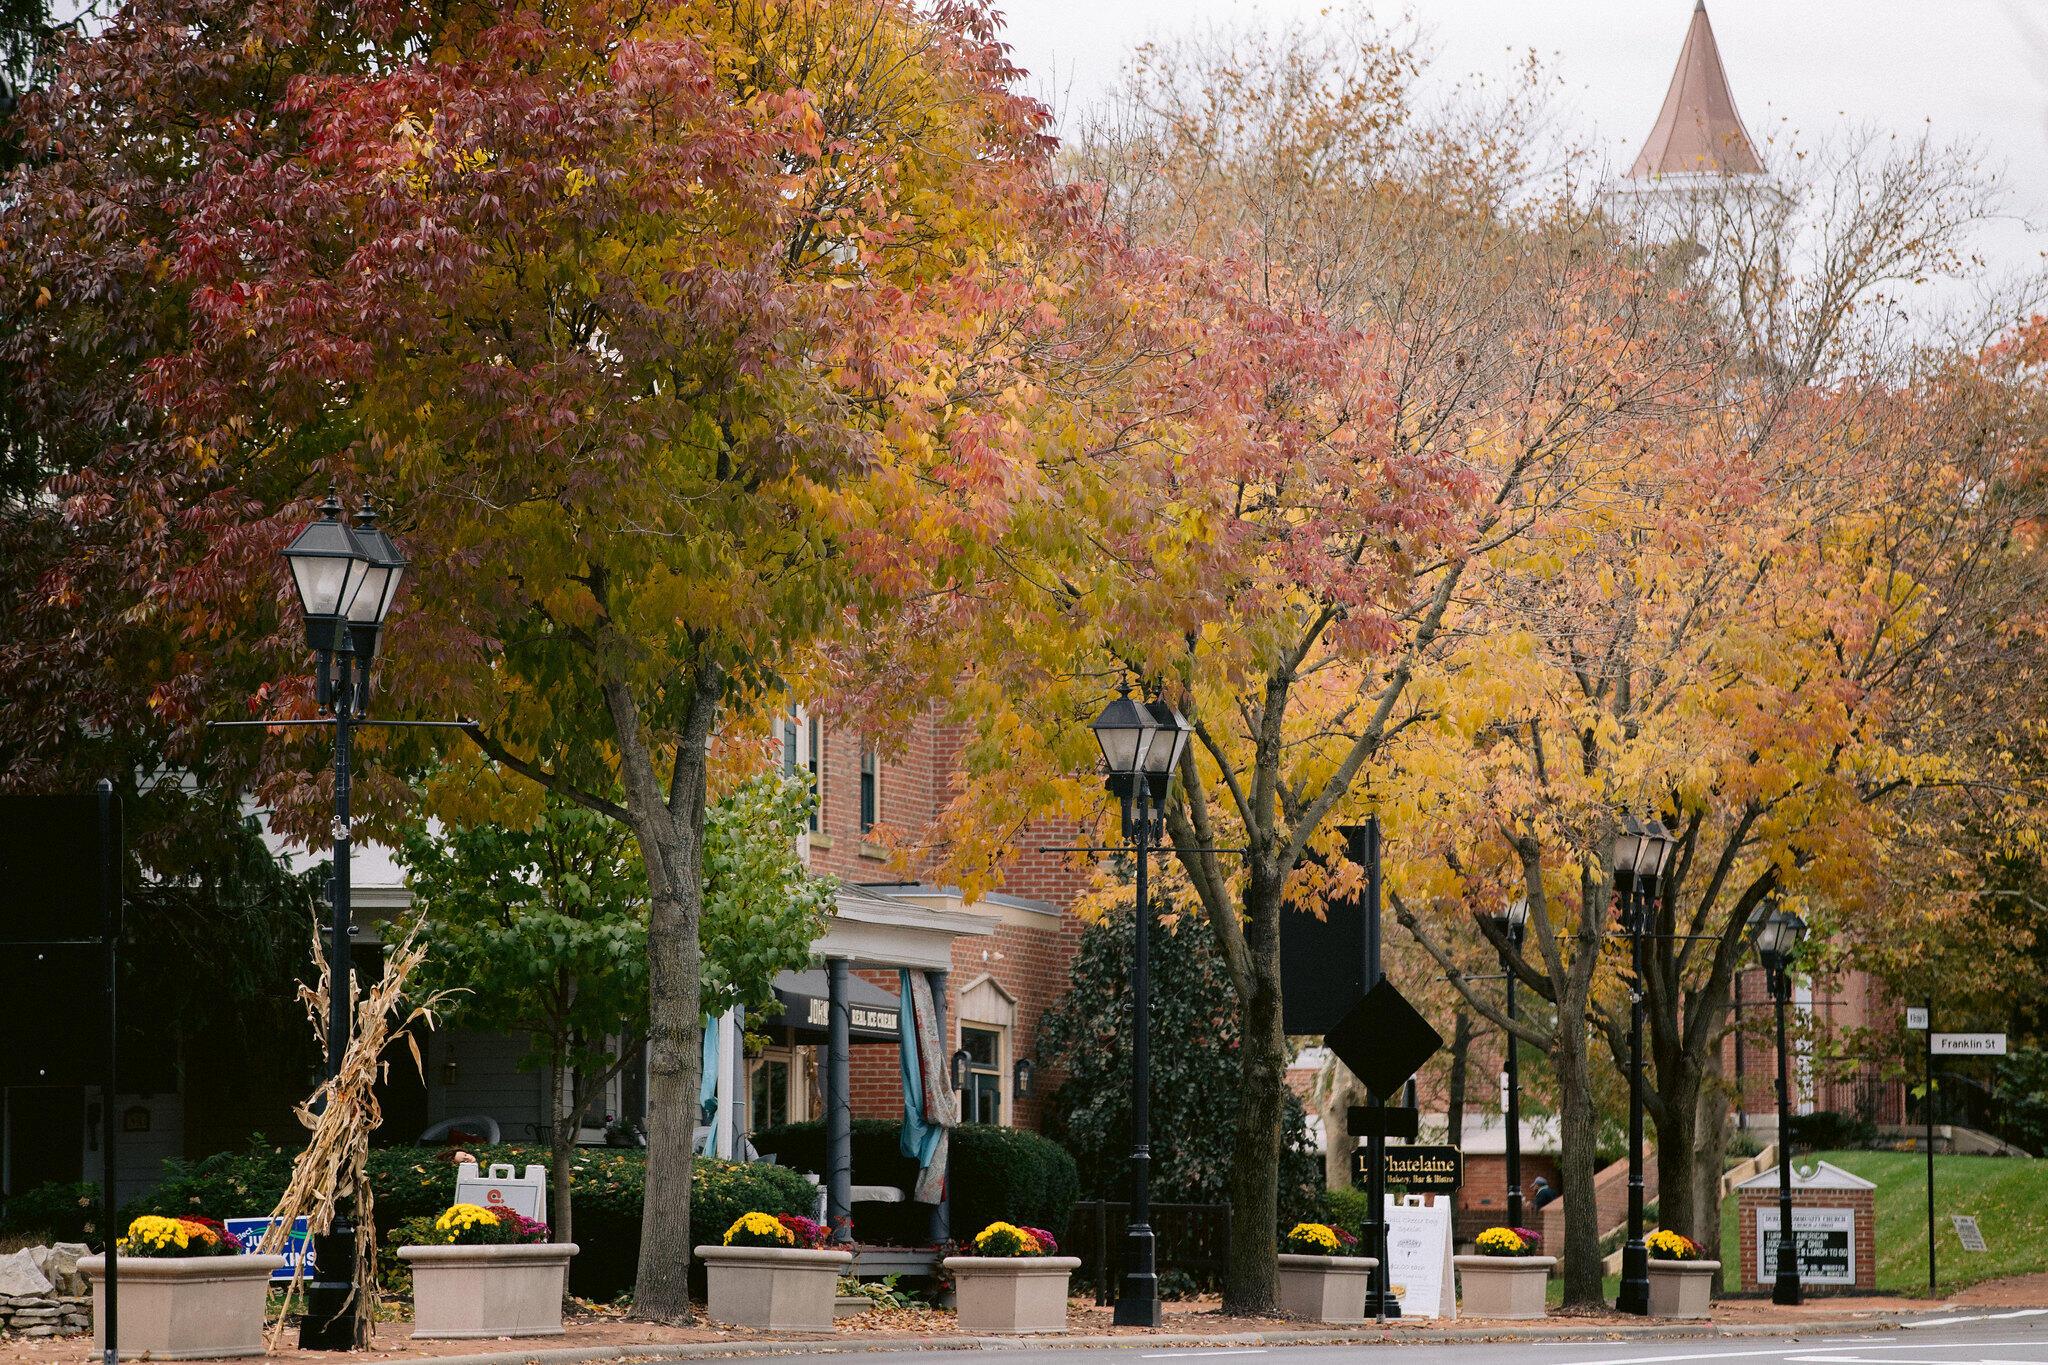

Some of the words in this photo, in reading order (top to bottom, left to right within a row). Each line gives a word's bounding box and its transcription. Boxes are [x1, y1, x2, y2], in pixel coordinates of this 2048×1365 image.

[867, 1011, 877, 1027] ICE
[877, 1012, 898, 1029] CREAM
[1941, 1039, 1982, 1050] Franklin
[1985, 1039, 1996, 1050] St
[1359, 1155, 1369, 1172] L
[1413, 1174, 1425, 1183] Bar
[1426, 1174, 1433, 1183] &
[236, 1227, 253, 1241] Elect
[1796, 1232, 1829, 1240] AMERICAN
[1807, 1248, 1828, 1257] LUNCH
[1829, 1248, 1838, 1257] TO
